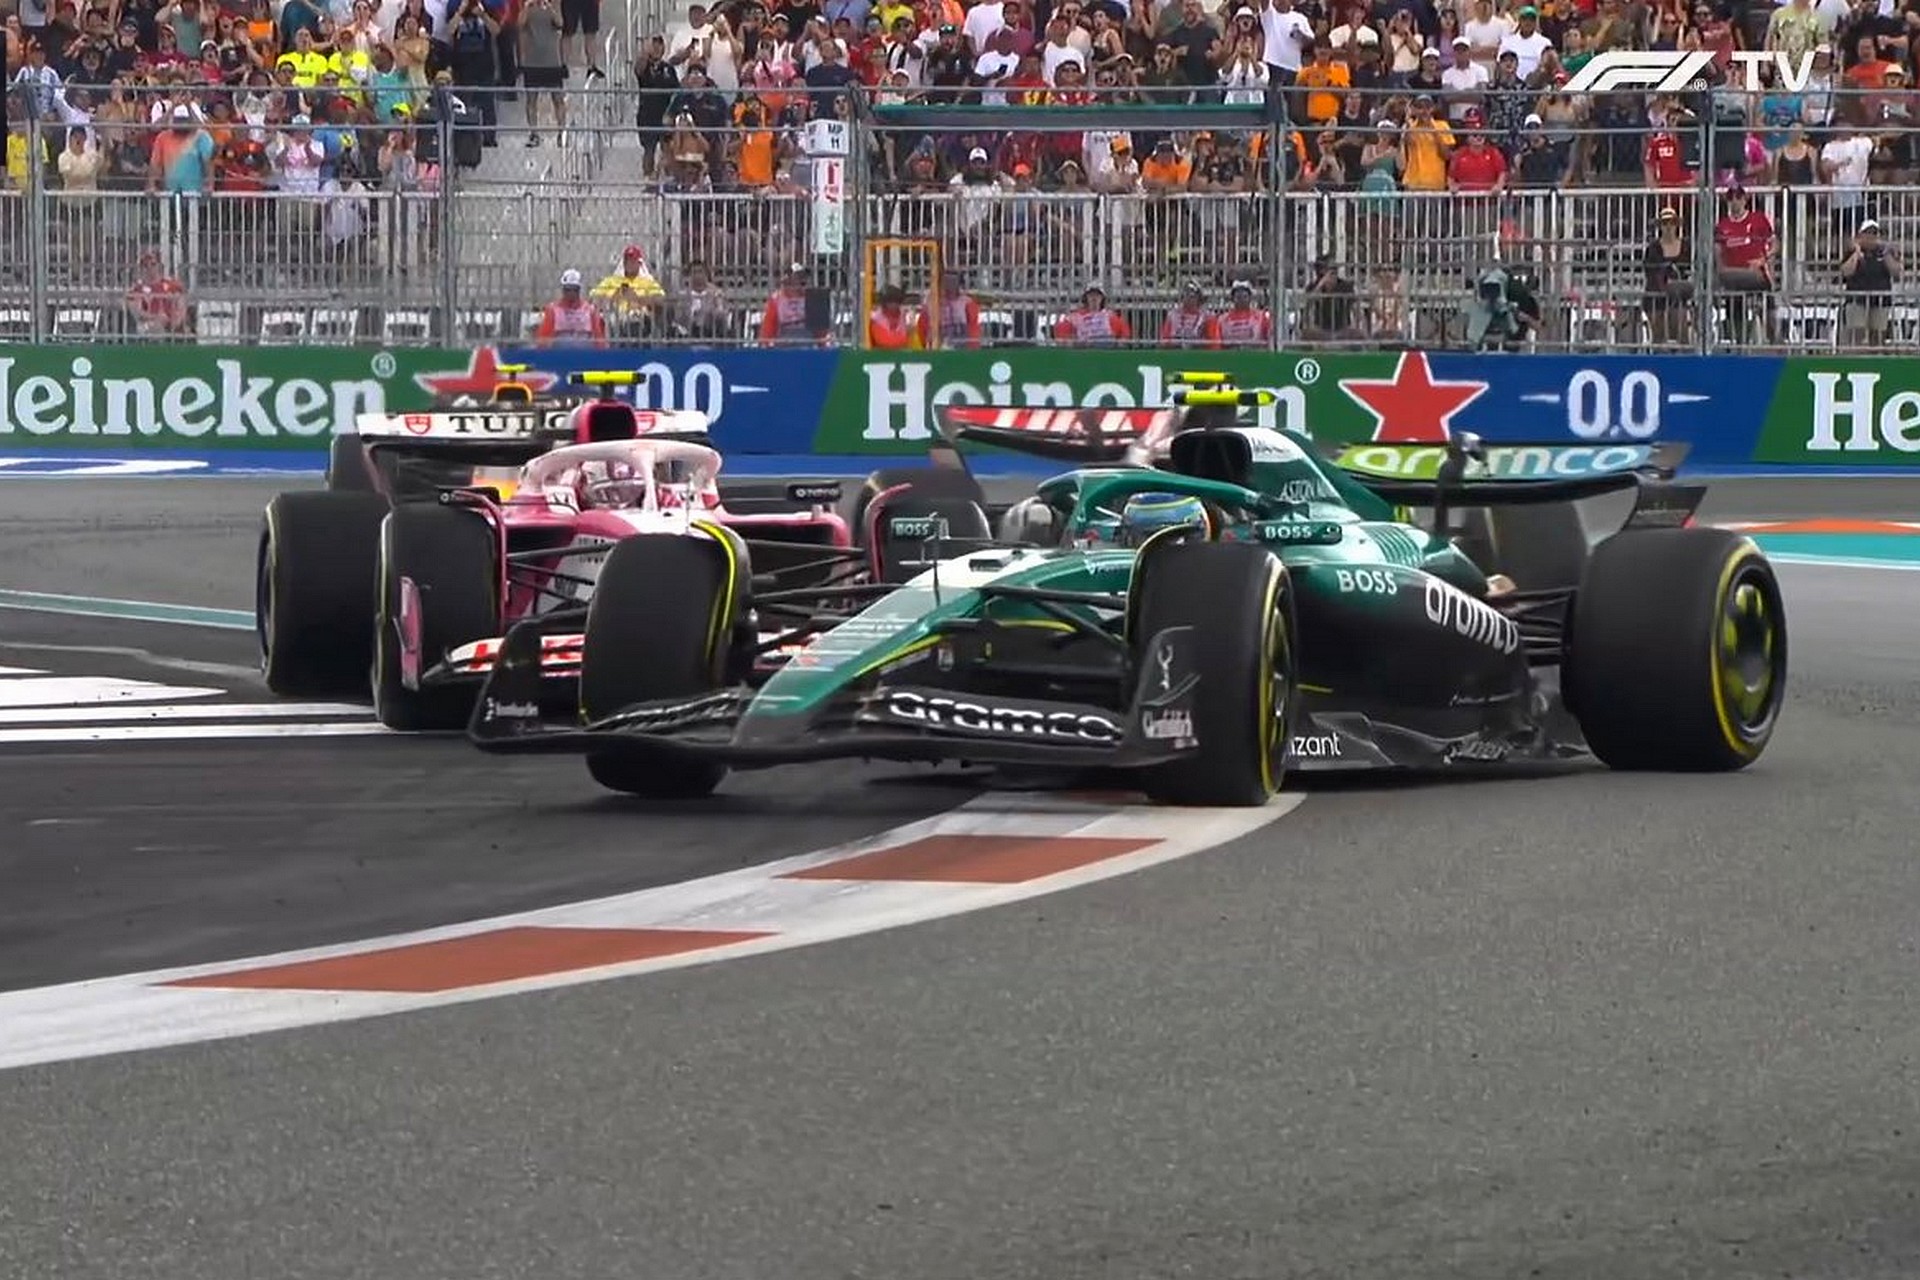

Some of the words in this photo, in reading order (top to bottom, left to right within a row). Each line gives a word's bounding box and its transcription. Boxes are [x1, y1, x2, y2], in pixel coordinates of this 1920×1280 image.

[0, 356, 388, 436] eineken
[1567, 369, 1660, 438] 0.0
[1353, 447, 1639, 476] armco
[895, 522, 930, 536] BOSS
[1264, 525, 1313, 540] BOSS
[1336, 569, 1398, 595] BOSS
[889, 692, 1124, 745] aramco
